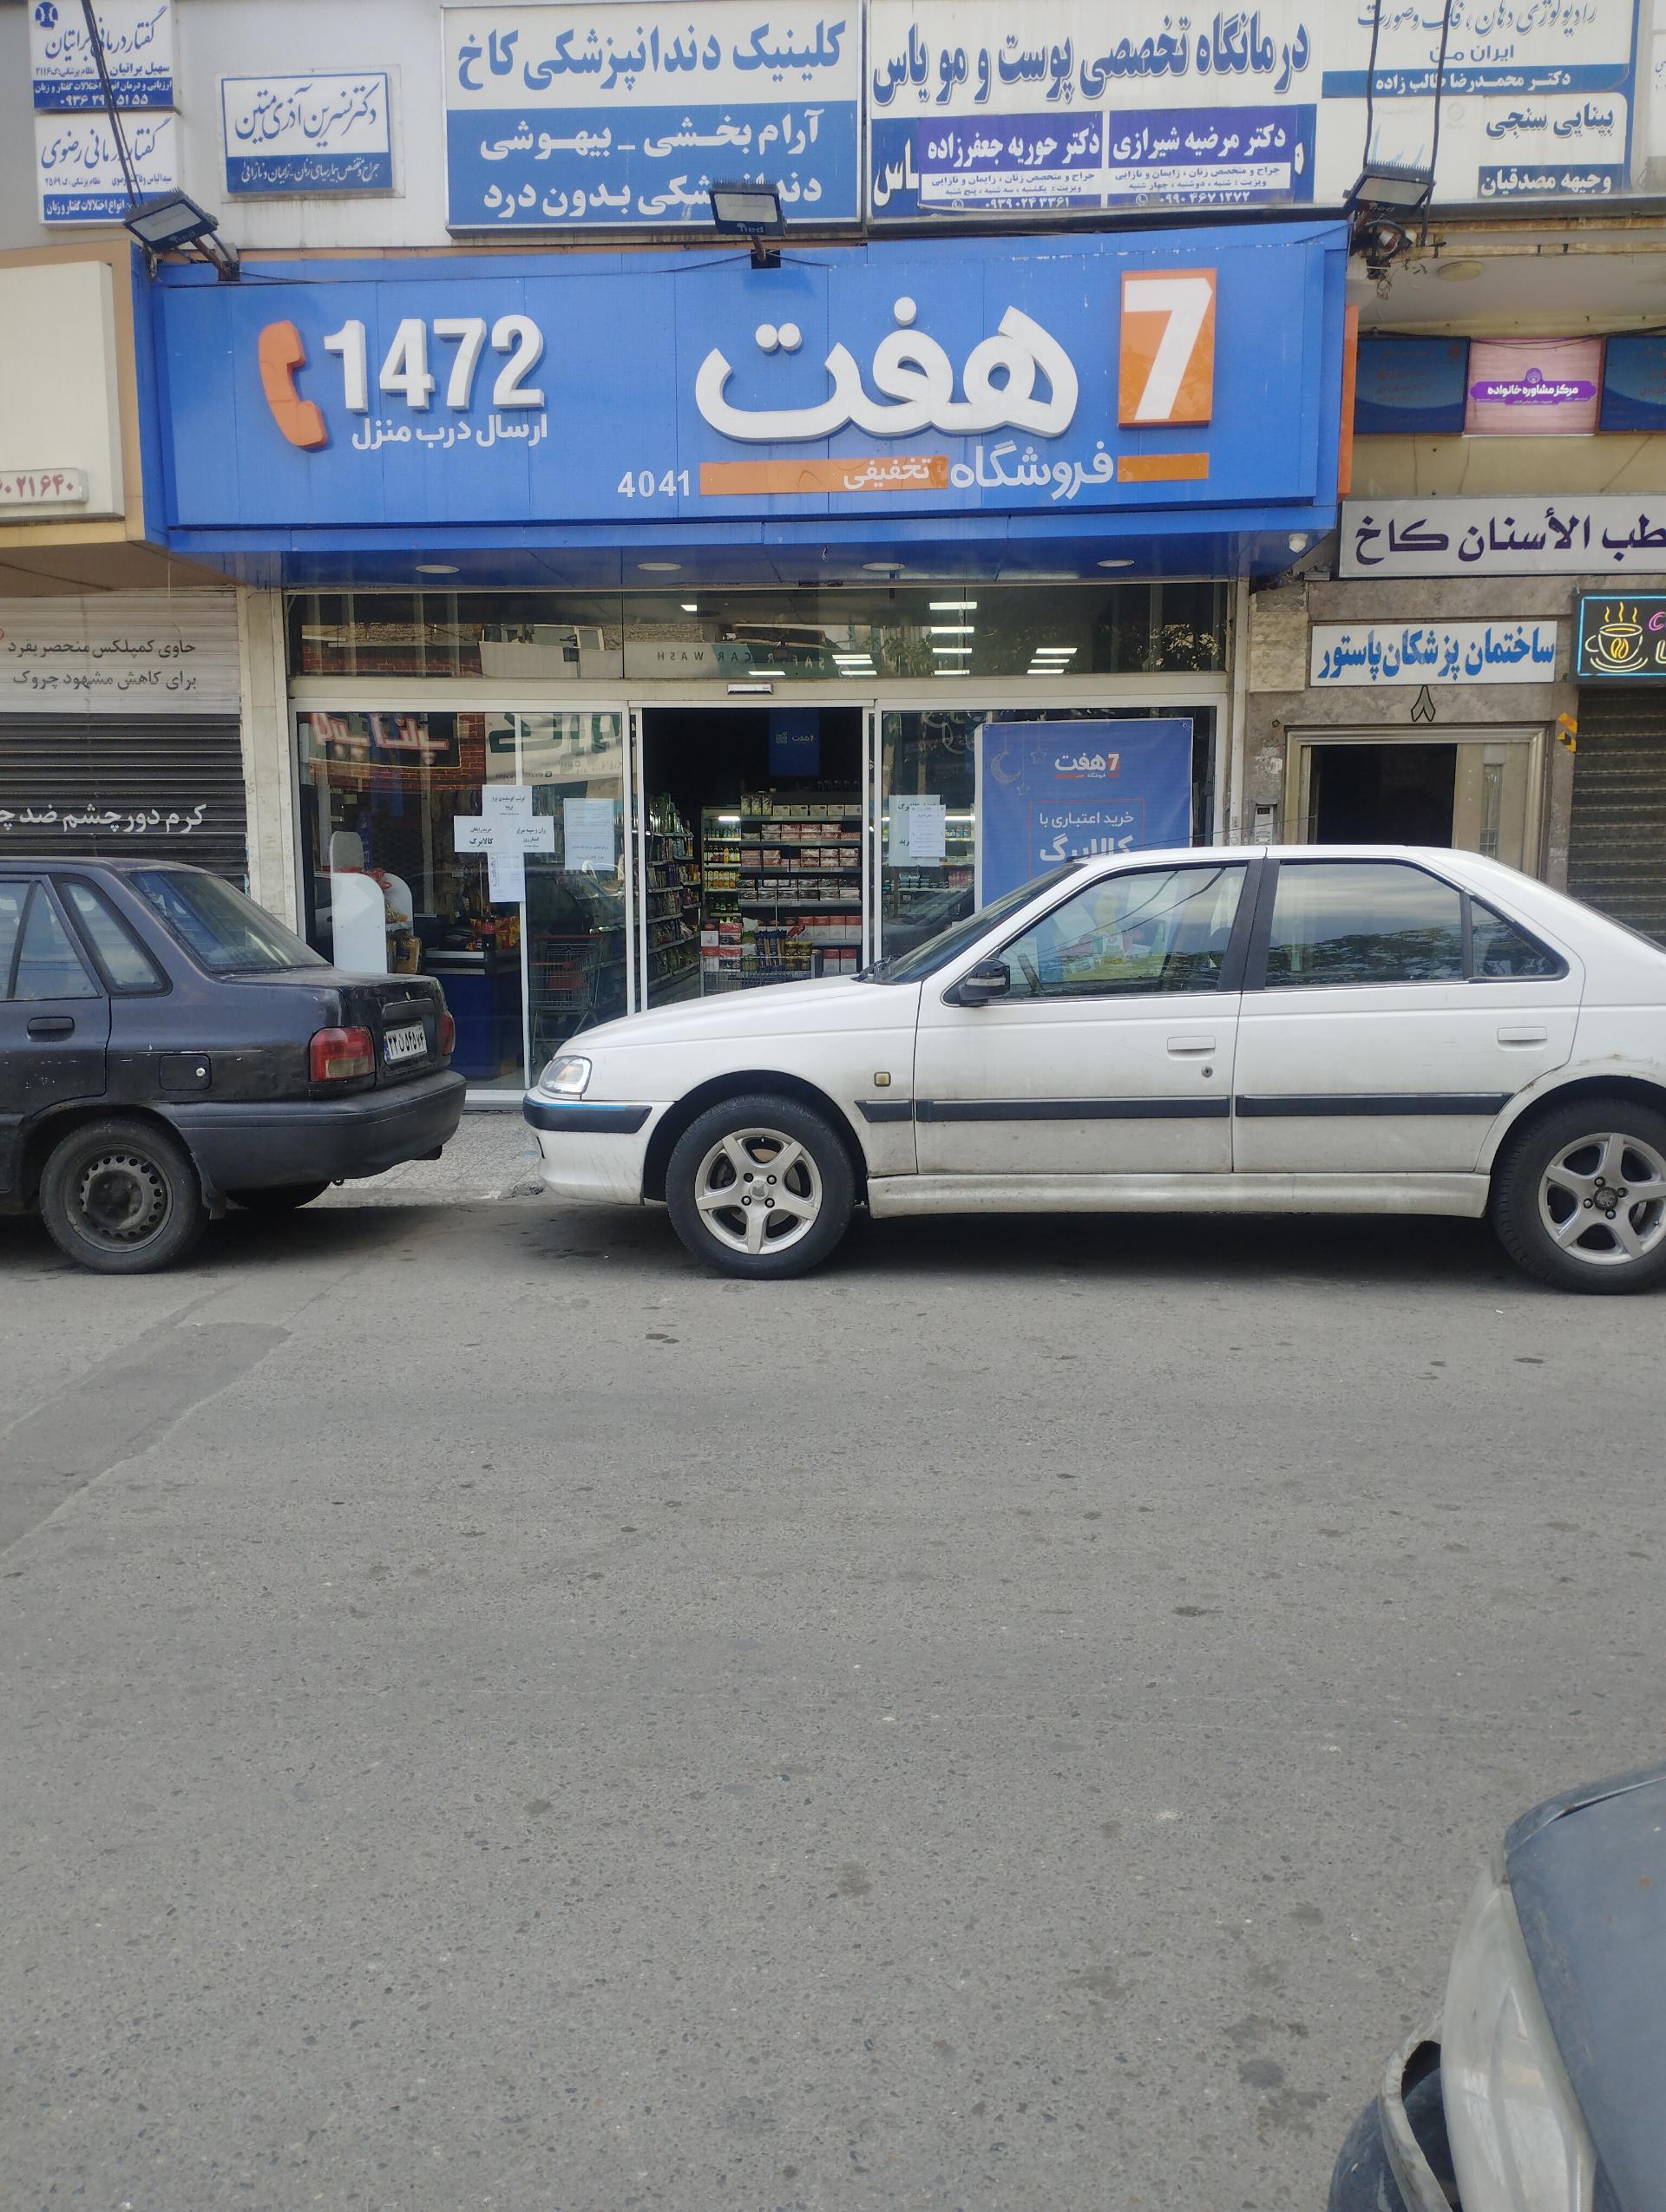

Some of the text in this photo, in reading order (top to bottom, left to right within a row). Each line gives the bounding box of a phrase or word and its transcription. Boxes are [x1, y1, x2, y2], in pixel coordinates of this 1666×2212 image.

[1475, 0, 1513, 36] دهان
[457, 19, 846, 91] کلینیک دندانپزشکی کاخ
[872, 10, 1310, 105] درمانگاه تخصصی پوست و مو یاس
[1429, 44, 1514, 62] ایران من
[110, 62, 169, 76] سهیل براتیان
[35, 83, 50, 94] زبان
[56, 82, 73, 94] گفتار
[74, 81, 102, 90] اختلالات
[121, 81, 141, 91] درمان
[148, 80, 172, 91] ارزیابی
[1375, 75, 1406, 94] زاده
[1450, 72, 1525, 94] محمدرضا
[1527, 70, 1571, 91] دکتر
[132, 94, 148, 105] ۵۵
[235, 82, 380, 147] دکتر نسرین آذری متین
[1486, 102, 1614, 138] بینایی سنجی
[480, 108, 823, 160] آرام بخشی بیهوشی
[1112, 123, 1286, 160] دکتر مرضیه شیرازی
[41, 130, 82, 168] رضوی
[1008, 134, 1058, 166] حوریه
[1061, 128, 1099, 164] دکتر
[362, 161, 380, 182] جراح
[968, 174, 996, 185] زایمان
[1005, 173, 1024, 184] زنان
[1026, 174, 1062, 183] متخصص
[1072, 172, 1095, 181] جراح
[1115, 170, 1142, 180] نازایی
[1152, 168, 1181, 179] زایمان
[1189, 168, 1209, 178] زنان
[1210, 167, 1246, 177] متخصص
[1257, 167, 1280, 176] جراح
[931, 176, 959, 187] نازایی
[1056, 185, 1082, 193] ویزیت
[1480, 167, 1612, 196] وجیهه مصدقیان
[483, 183, 536, 218] درد
[542, 184, 631, 216] بدون
[1159, 193, 1185, 205] ۰۹۹۰
[324, 315, 545, 413] 1472
[694, 277, 1213, 441] 7 هفت
[1487, 383, 1579, 397] مرکز مشاوره خانواده
[351, 414, 548, 450] ارسال درب منزل
[843, 441, 1114, 501] فروشگاه تخفیفی
[0, 474, 74, 500] ۰۲۱۶۴۰
[618, 468, 690, 498] 4041
[1458, 507, 1591, 562] الأسنان
[41, 640, 89, 658] منحصر
[93, 638, 155, 658] کمپلکس
[158, 640, 196, 658] حاوی
[1317, 625, 1555, 681] ساختمان پزشکان پاستور
[14, 671, 197, 690] برای کاهش مشهود چروک
[1055, 752, 1119, 771] 7 هفت
[19, 804, 57, 823] ضد
[63, 803, 122, 833] چشم
[122, 809, 160, 833] دور
[165, 804, 207, 833] کرم
[1040, 811, 1134, 828] خرید اعتباری با
